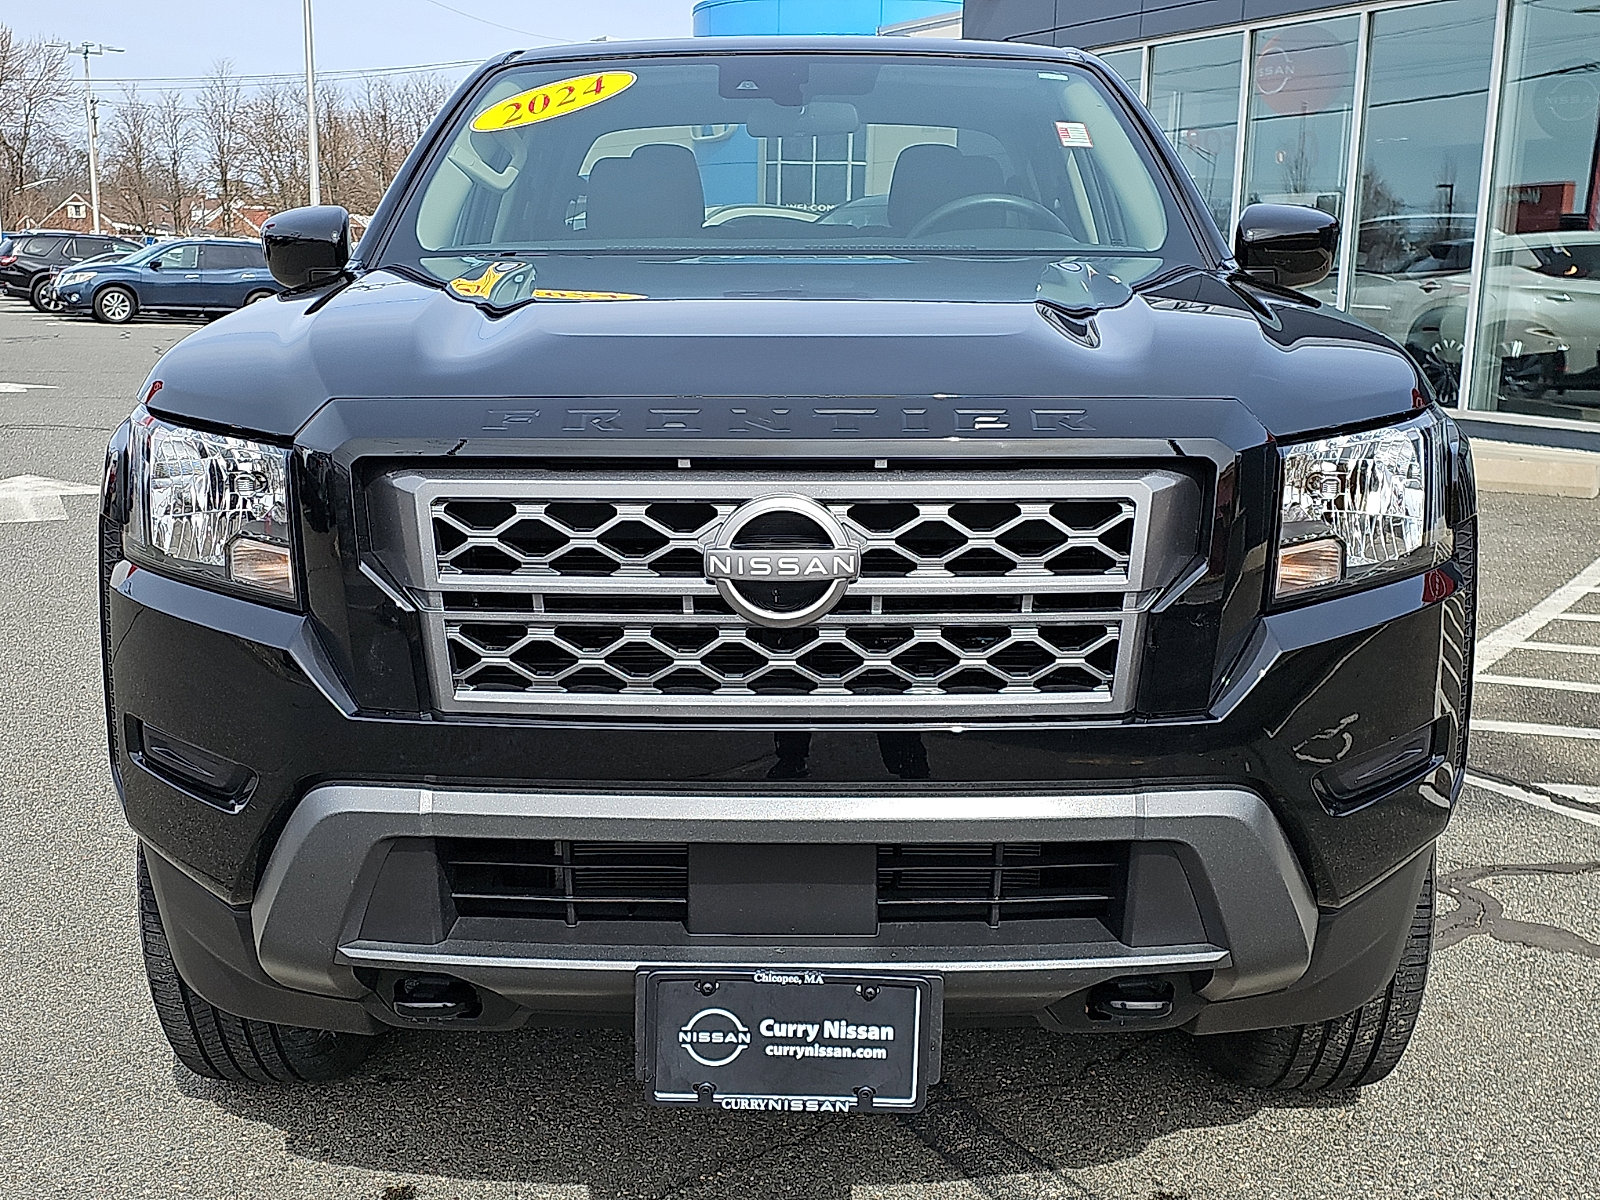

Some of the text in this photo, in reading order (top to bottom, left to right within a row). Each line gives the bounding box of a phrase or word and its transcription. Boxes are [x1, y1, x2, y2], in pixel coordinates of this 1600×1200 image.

[503, 75, 605, 125] 2024
[482, 407, 1096, 432] FRONTIER
[709, 555, 855, 576] NISSAN
[804, 974, 825, 984] MA
[678, 1031, 751, 1044] NISSAN
[759, 1018, 895, 1042] Curry Nissan
[765, 1043, 888, 1060] currynissan.com
